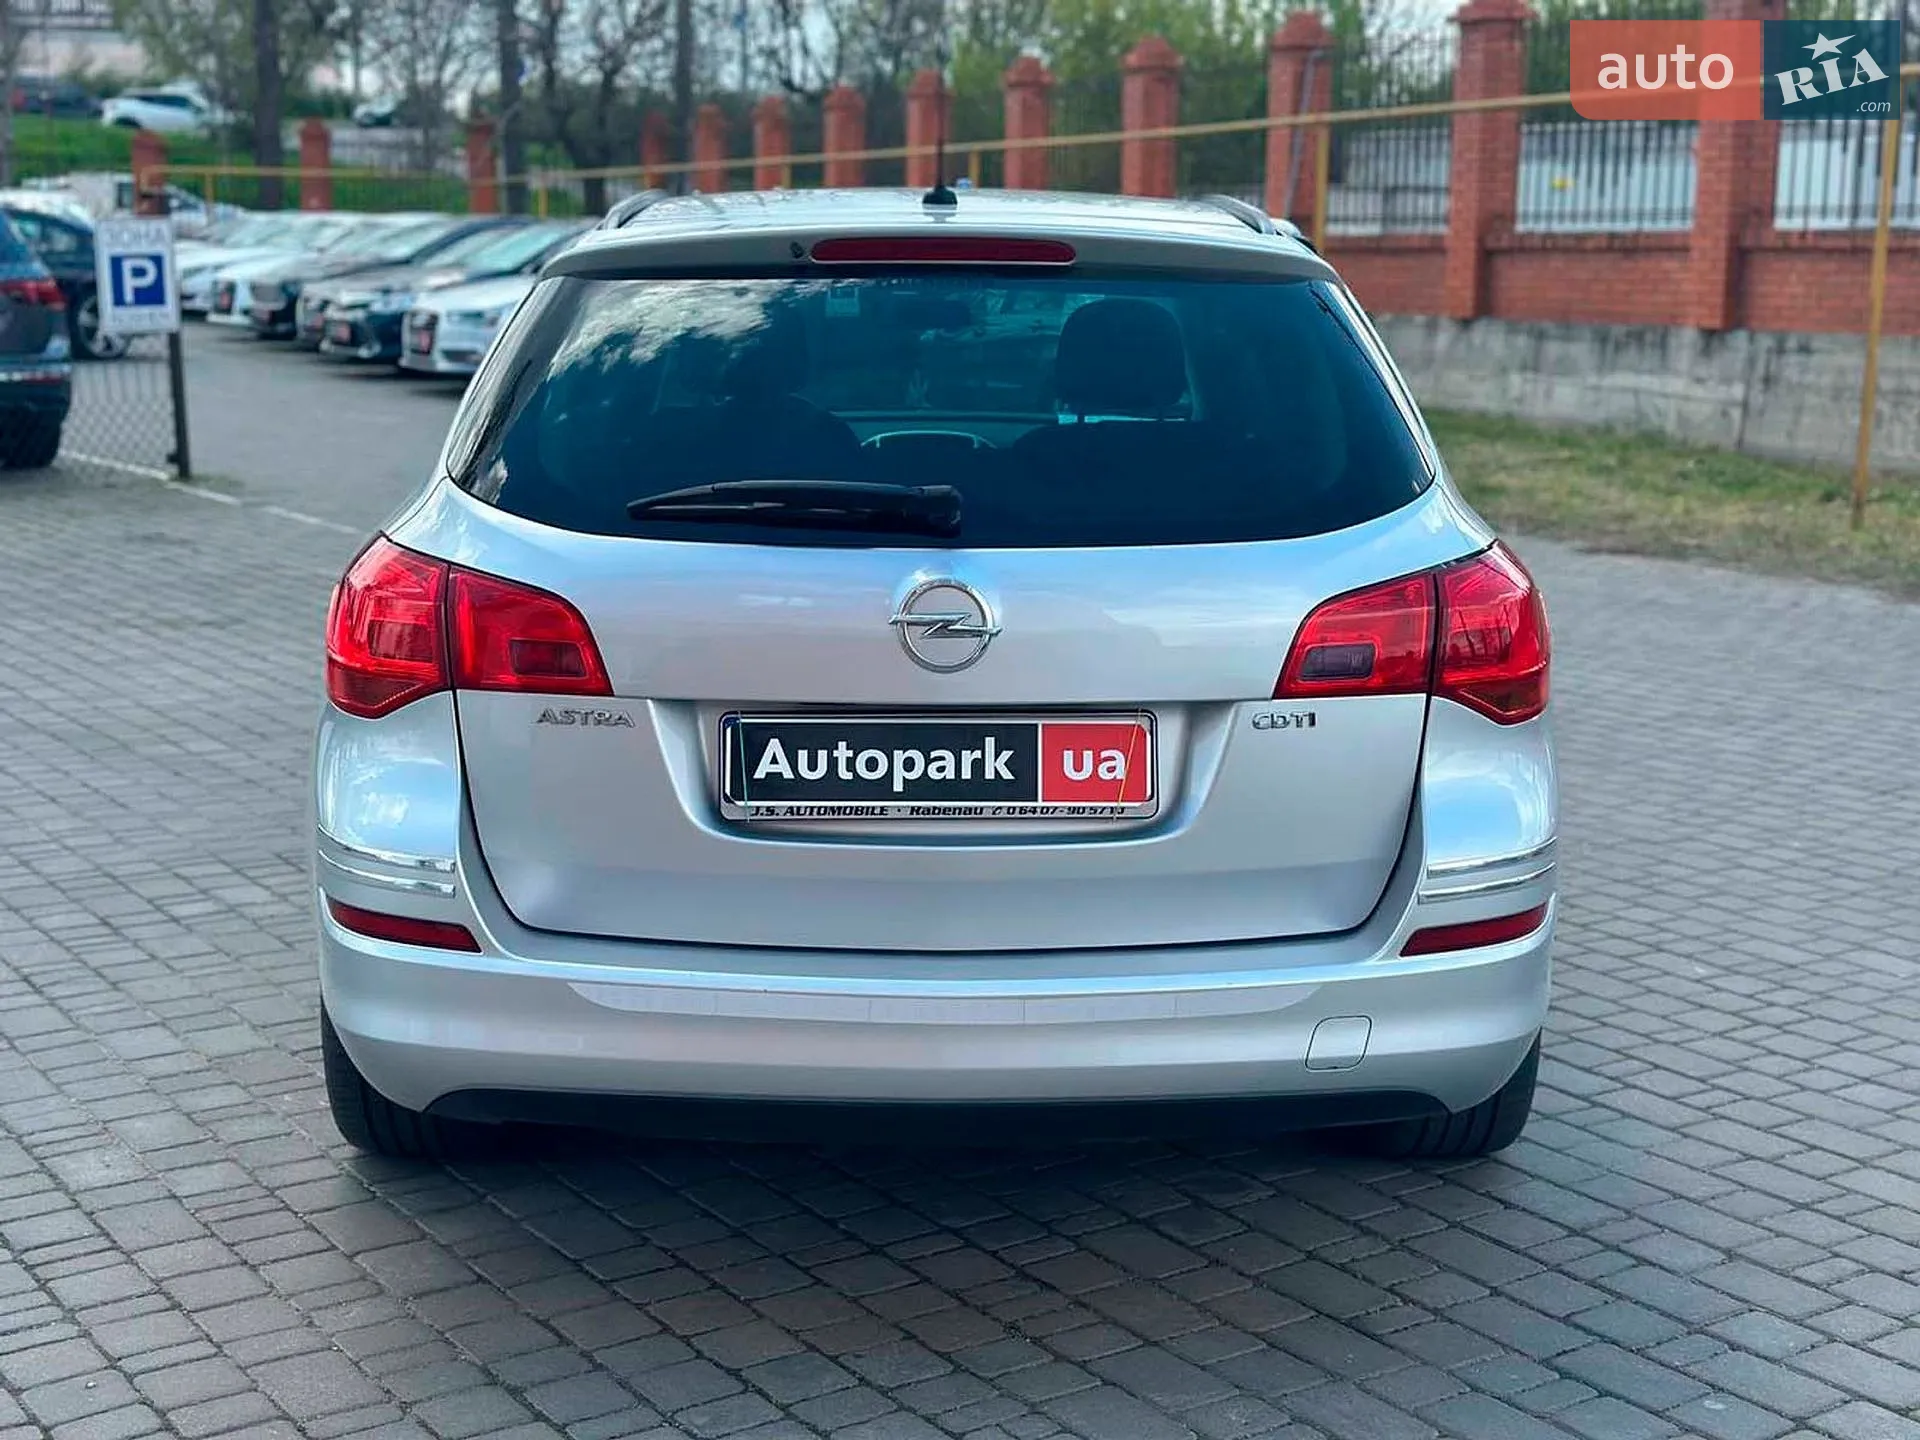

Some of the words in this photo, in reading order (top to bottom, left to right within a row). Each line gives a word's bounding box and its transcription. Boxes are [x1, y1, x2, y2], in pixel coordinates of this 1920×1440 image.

[121, 257, 159, 305] P
[536, 708, 637, 729] ASTRA
[1252, 711, 1317, 730] CDTI
[752, 736, 1016, 793] Autopark
[1062, 748, 1125, 782] ua
[783, 805, 889, 817] AUTOMOBILE
[909, 805, 984, 817] Rabenau
